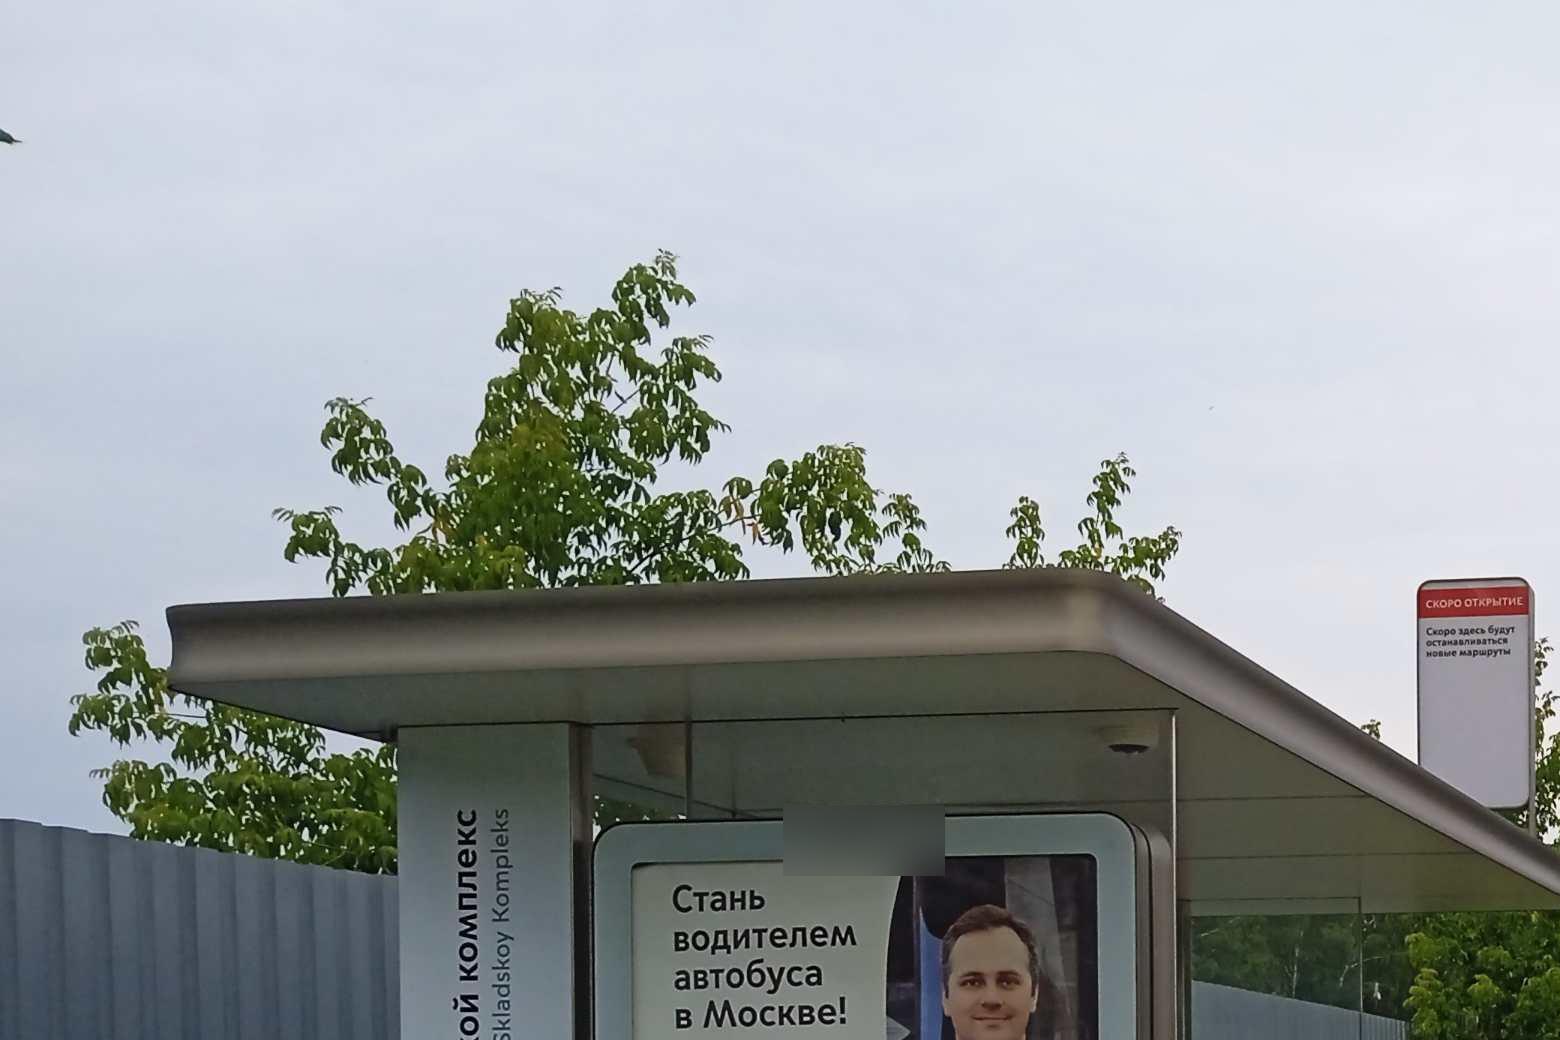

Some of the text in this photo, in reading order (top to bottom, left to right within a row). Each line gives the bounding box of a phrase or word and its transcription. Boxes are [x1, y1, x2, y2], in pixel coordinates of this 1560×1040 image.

[1426, 597, 1523, 608] СКОРО ОТКРЫТИЕ
[1426, 625, 1515, 638] Скоро здесь будут
[1426, 637, 1508, 647] останавливаться
[1426, 648, 1510, 657] новые маршруты
[490, 808, 513, 922] Kompleks
[456, 809, 479, 981] комплекс
[673, 885, 765, 913] Стань
[674, 925, 856, 955] водителем
[675, 958, 822, 994] автобуса
[676, 997, 846, 1029] в Москве!
